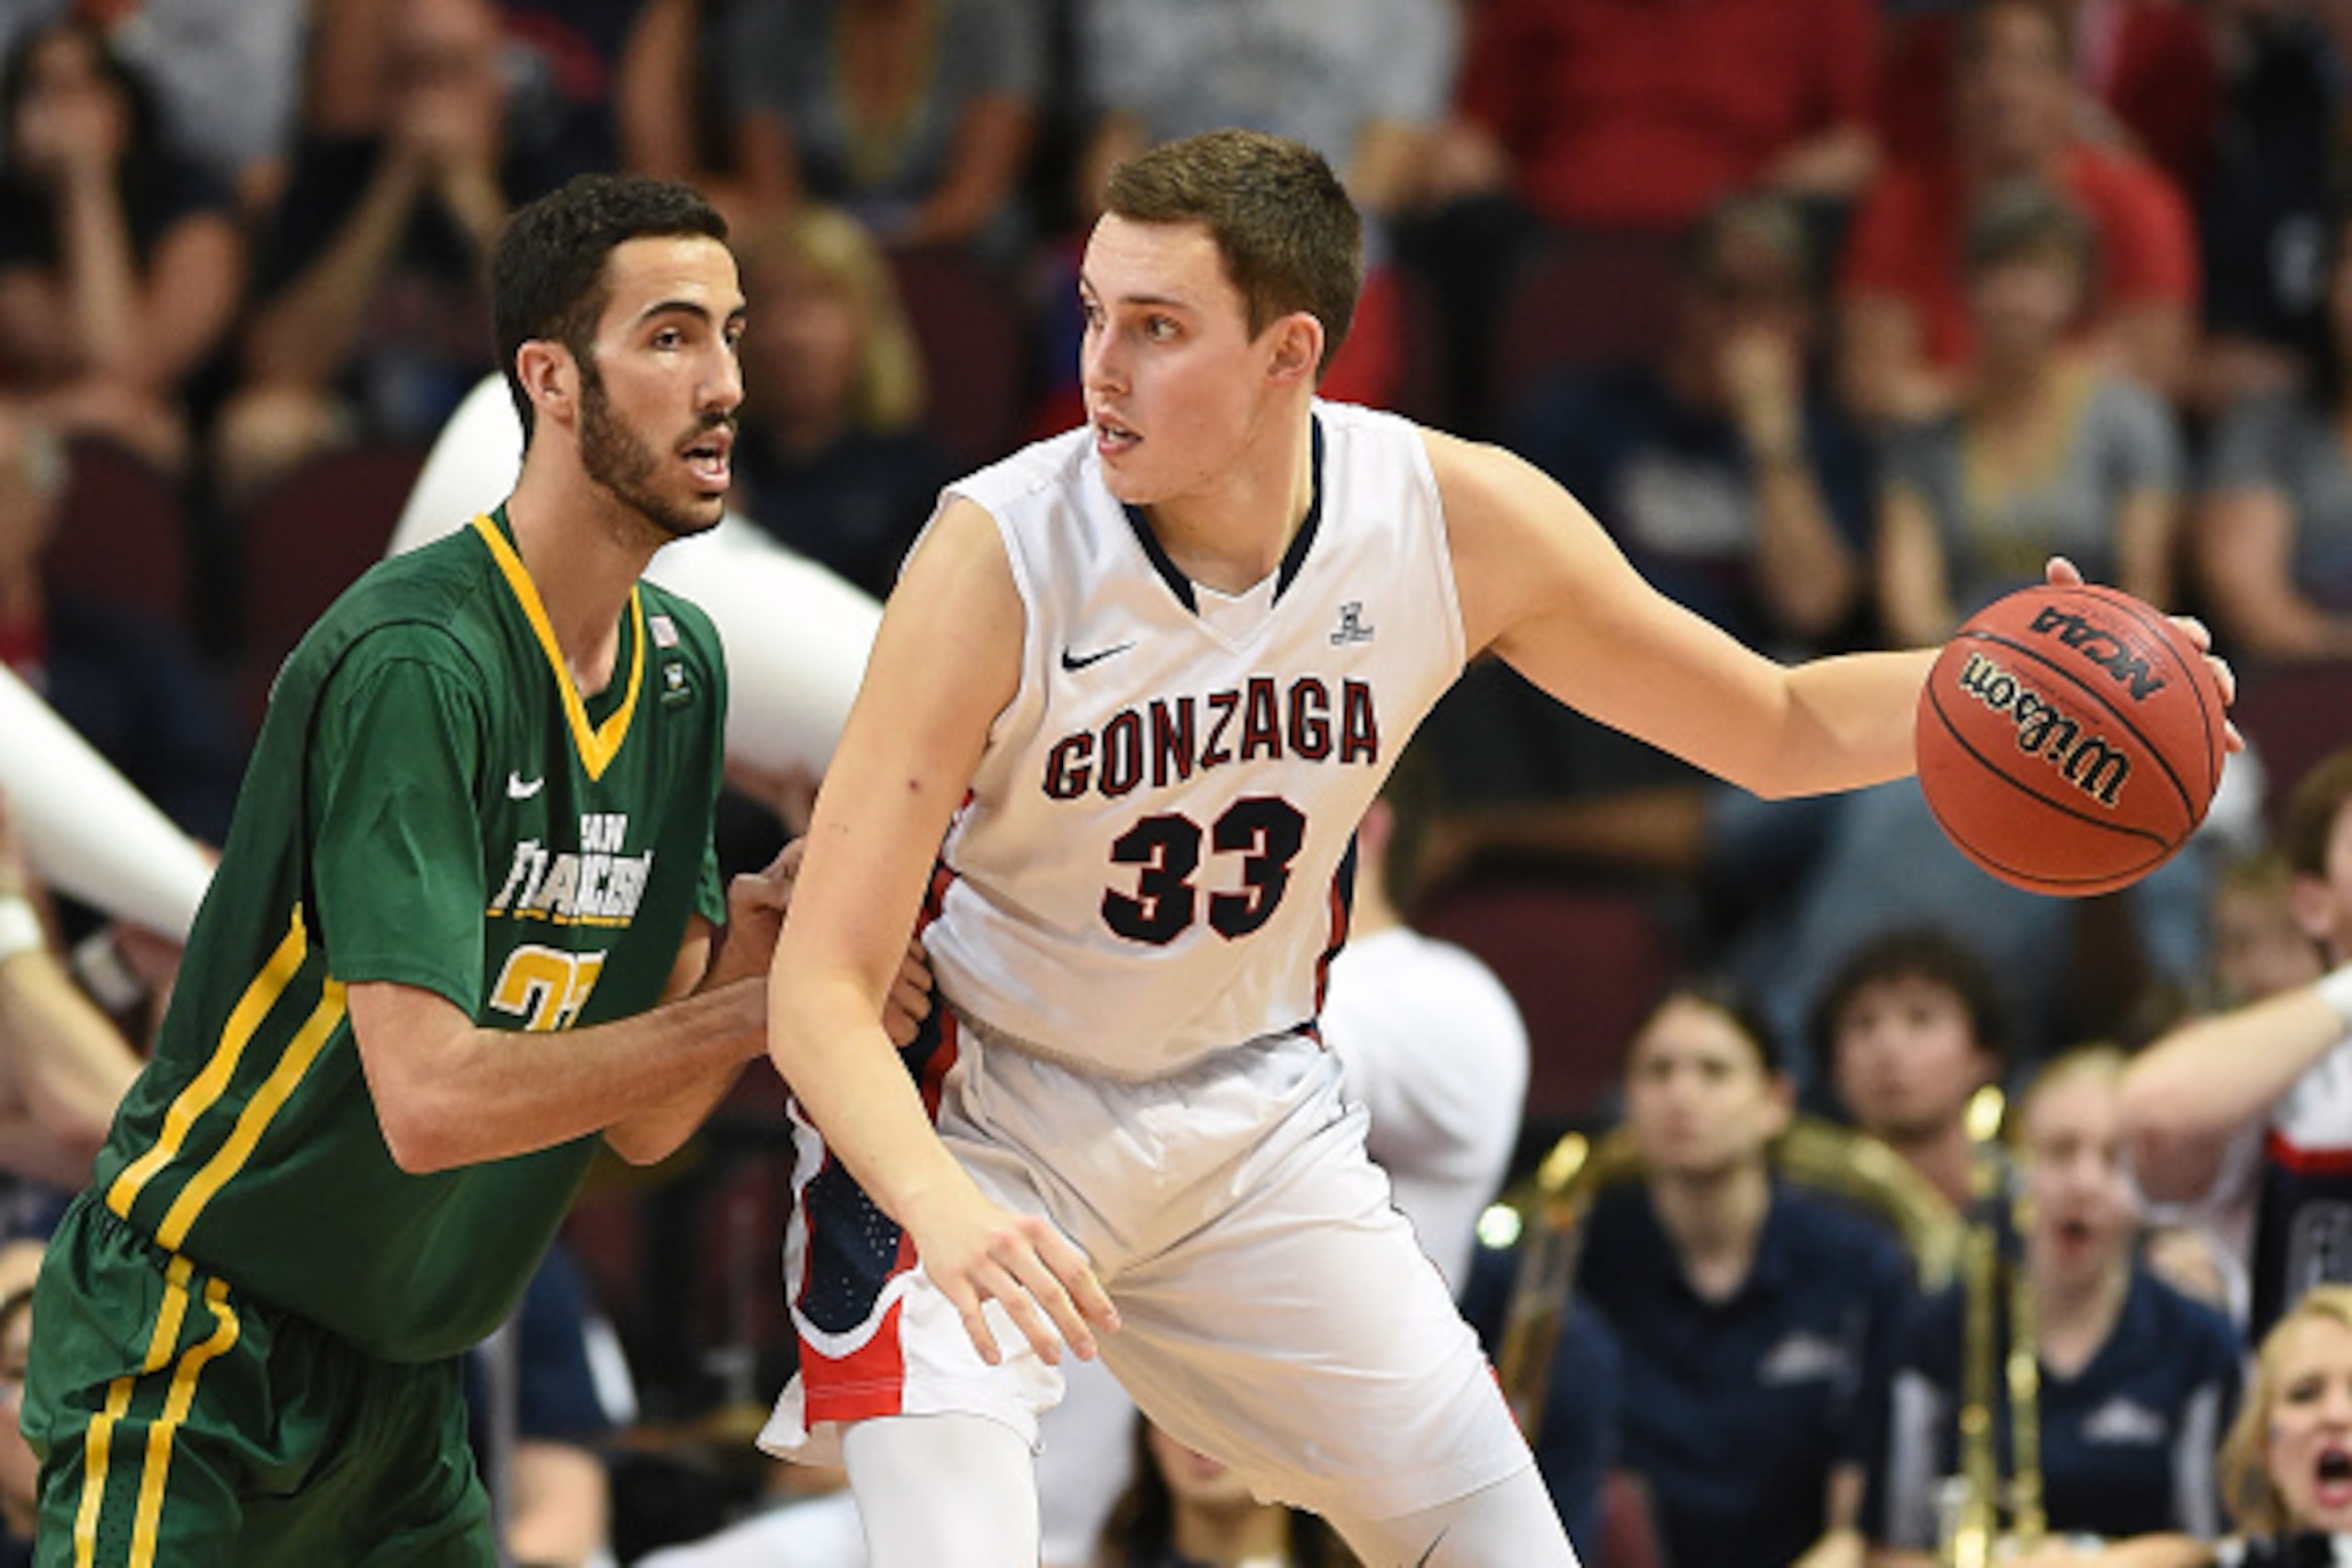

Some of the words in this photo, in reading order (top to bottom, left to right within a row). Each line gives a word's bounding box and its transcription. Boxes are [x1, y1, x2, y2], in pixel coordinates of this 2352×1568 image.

[2029, 605, 2165, 702] NCAA
[1042, 675, 1379, 800] GONZAGA
[1958, 651, 2132, 809] Wilson
[1101, 795, 1307, 947] 33
